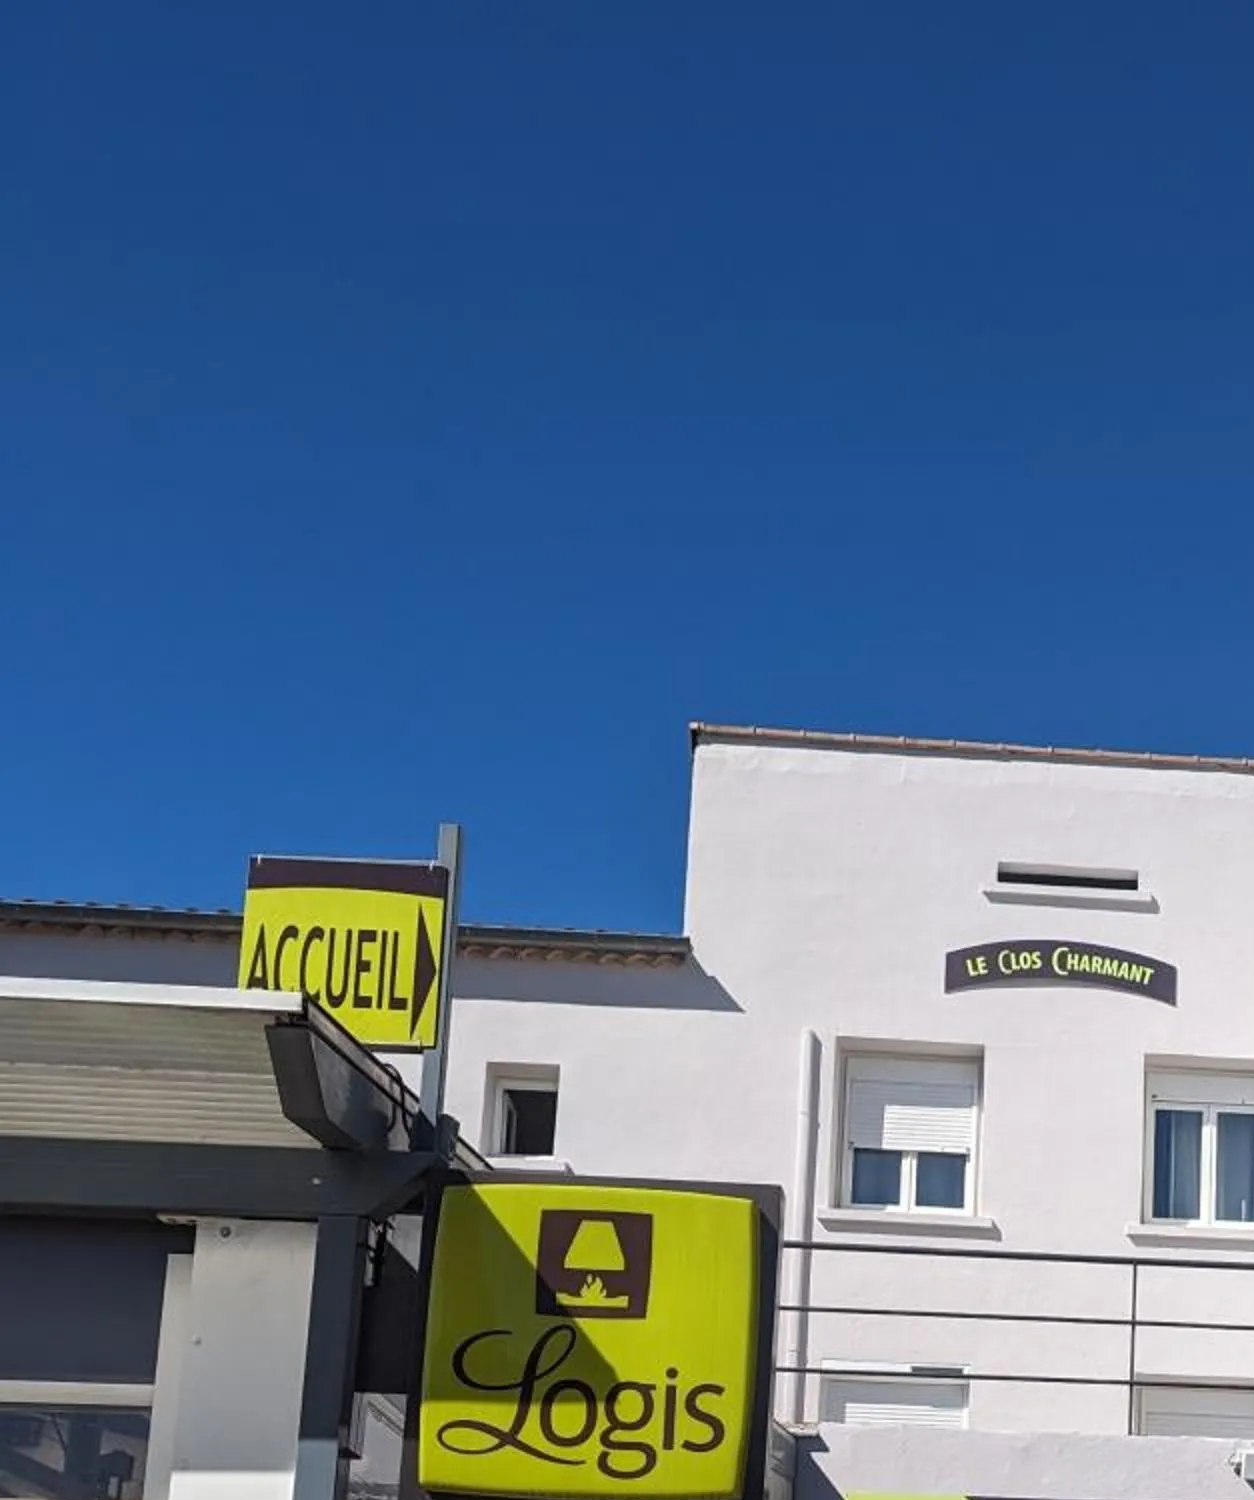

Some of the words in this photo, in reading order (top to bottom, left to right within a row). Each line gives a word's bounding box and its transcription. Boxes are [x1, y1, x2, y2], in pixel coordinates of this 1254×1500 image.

[246, 922, 409, 1010] ACCUEIL
[965, 955, 989, 977] LE
[997, 949, 1043, 975] CLOS
[1051, 946, 1156, 986] CHARMANT
[437, 1323, 726, 1480] Logis
